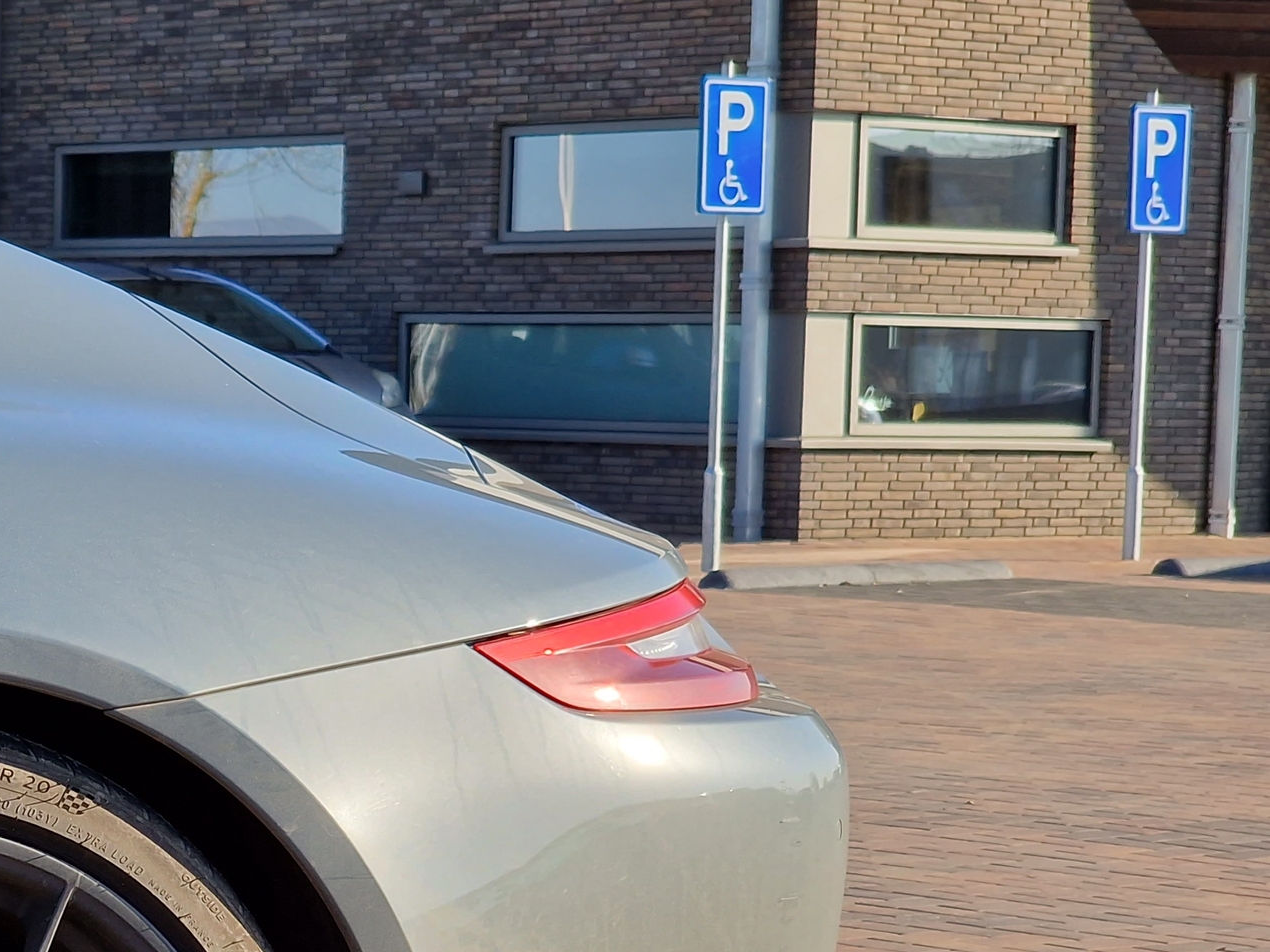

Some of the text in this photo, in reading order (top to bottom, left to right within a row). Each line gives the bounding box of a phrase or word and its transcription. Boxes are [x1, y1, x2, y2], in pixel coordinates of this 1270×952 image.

[719, 91, 754, 156] P
[1146, 118, 1177, 178] P
[22, 775, 51, 794] 20
[66, 823, 108, 852] EXTRA
[110, 850, 144, 877] LOAD
[181, 872, 226, 922] OUTSIDE
[185, 913, 214, 949] FRANCE
